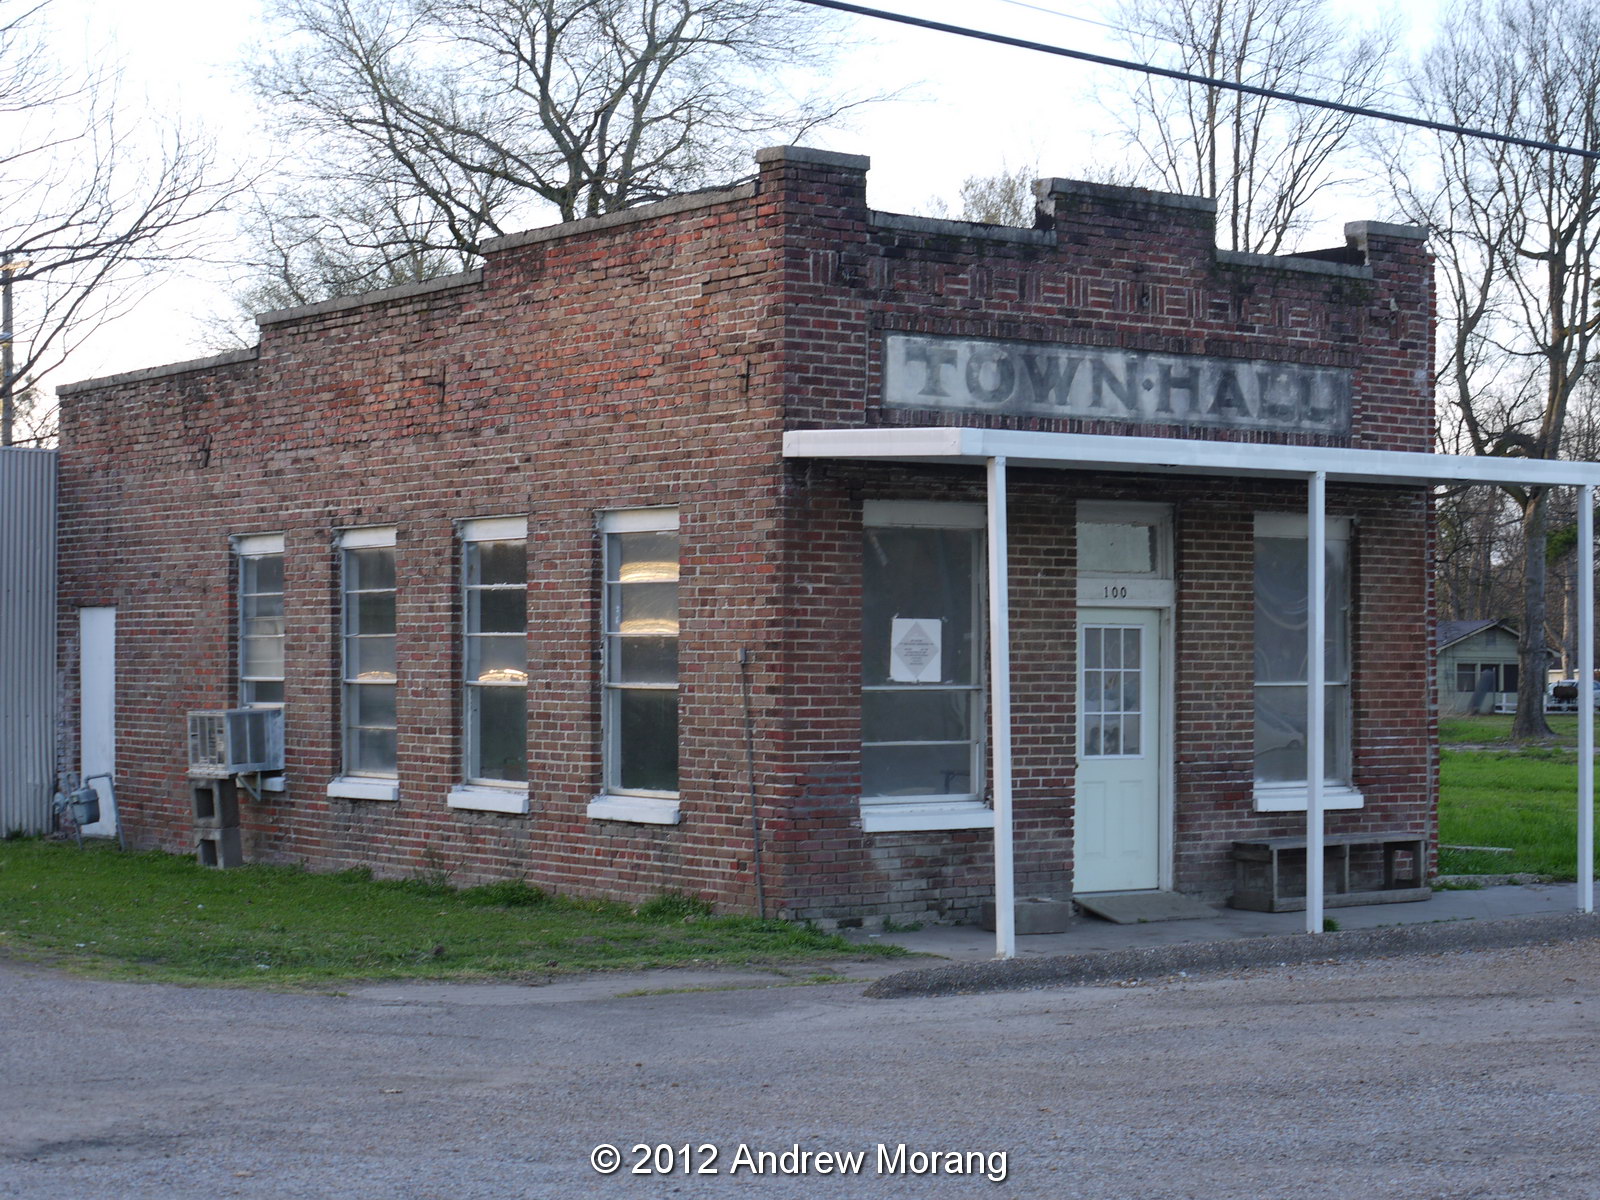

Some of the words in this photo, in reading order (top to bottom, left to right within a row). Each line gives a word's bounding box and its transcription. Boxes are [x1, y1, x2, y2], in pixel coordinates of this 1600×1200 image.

[904, 345, 1139, 412] TOWN
[1155, 362, 1337, 422] HALL
[1104, 586, 1127, 599] 100
